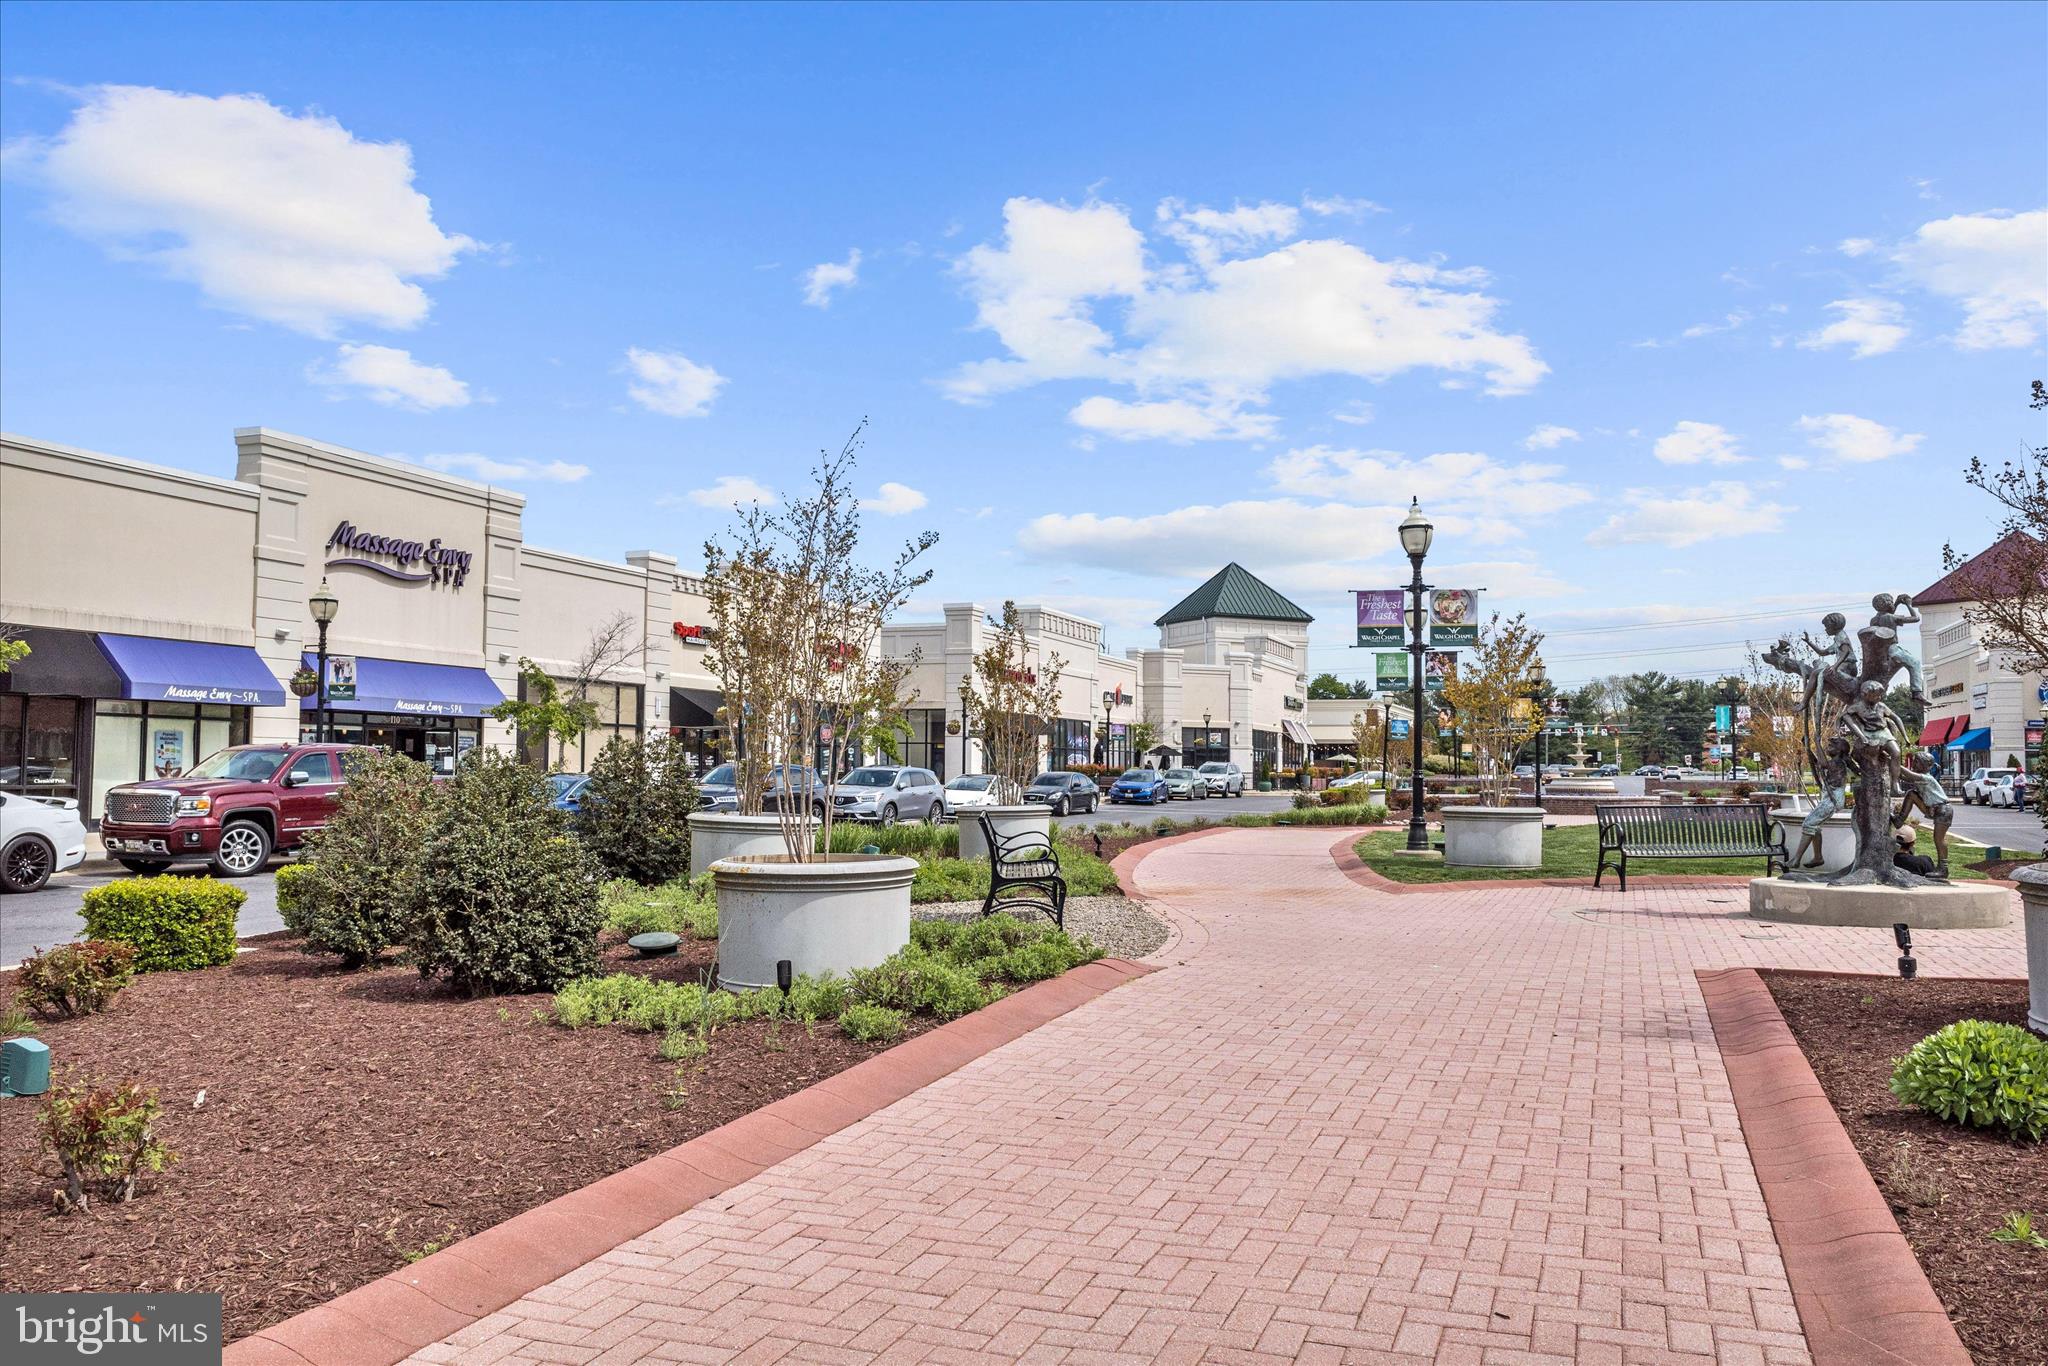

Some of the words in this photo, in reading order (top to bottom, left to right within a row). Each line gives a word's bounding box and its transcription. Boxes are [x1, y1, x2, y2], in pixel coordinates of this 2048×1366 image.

[325, 520, 424, 565] Massage
[423, 538, 473, 574] Envy
[431, 566, 464, 587] SPA
[1360, 598, 1402, 609] Freshest
[1367, 593, 1380, 601] The
[1370, 609, 1398, 620] Taste
[164, 685, 207, 700] Massage
[209, 688, 232, 702] Envy
[394, 699, 426, 713] Massage
[426, 701, 443, 714] Envy
[390, 716, 401, 724] 110
